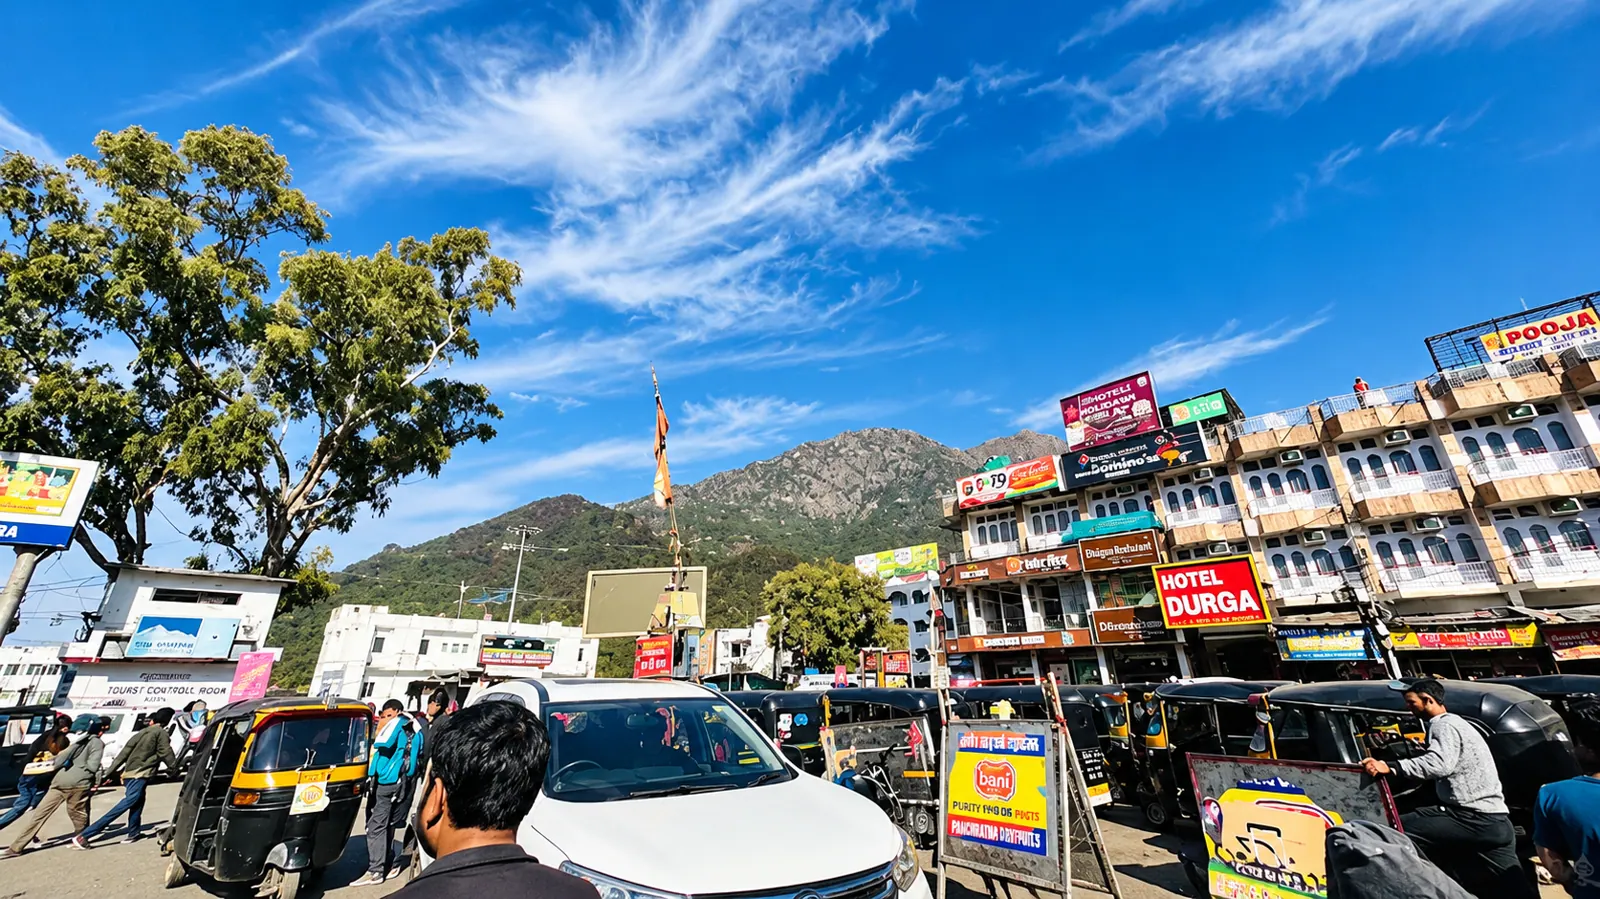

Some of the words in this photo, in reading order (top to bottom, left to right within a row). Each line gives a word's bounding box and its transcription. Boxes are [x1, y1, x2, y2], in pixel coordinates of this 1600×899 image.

[1506, 312, 1596, 344] POOJA
[1161, 569, 1224, 590] HOTEL
[1165, 589, 1260, 617] DURGA
[980, 772, 1010, 788] bani
[953, 801, 981, 813] PURITY
